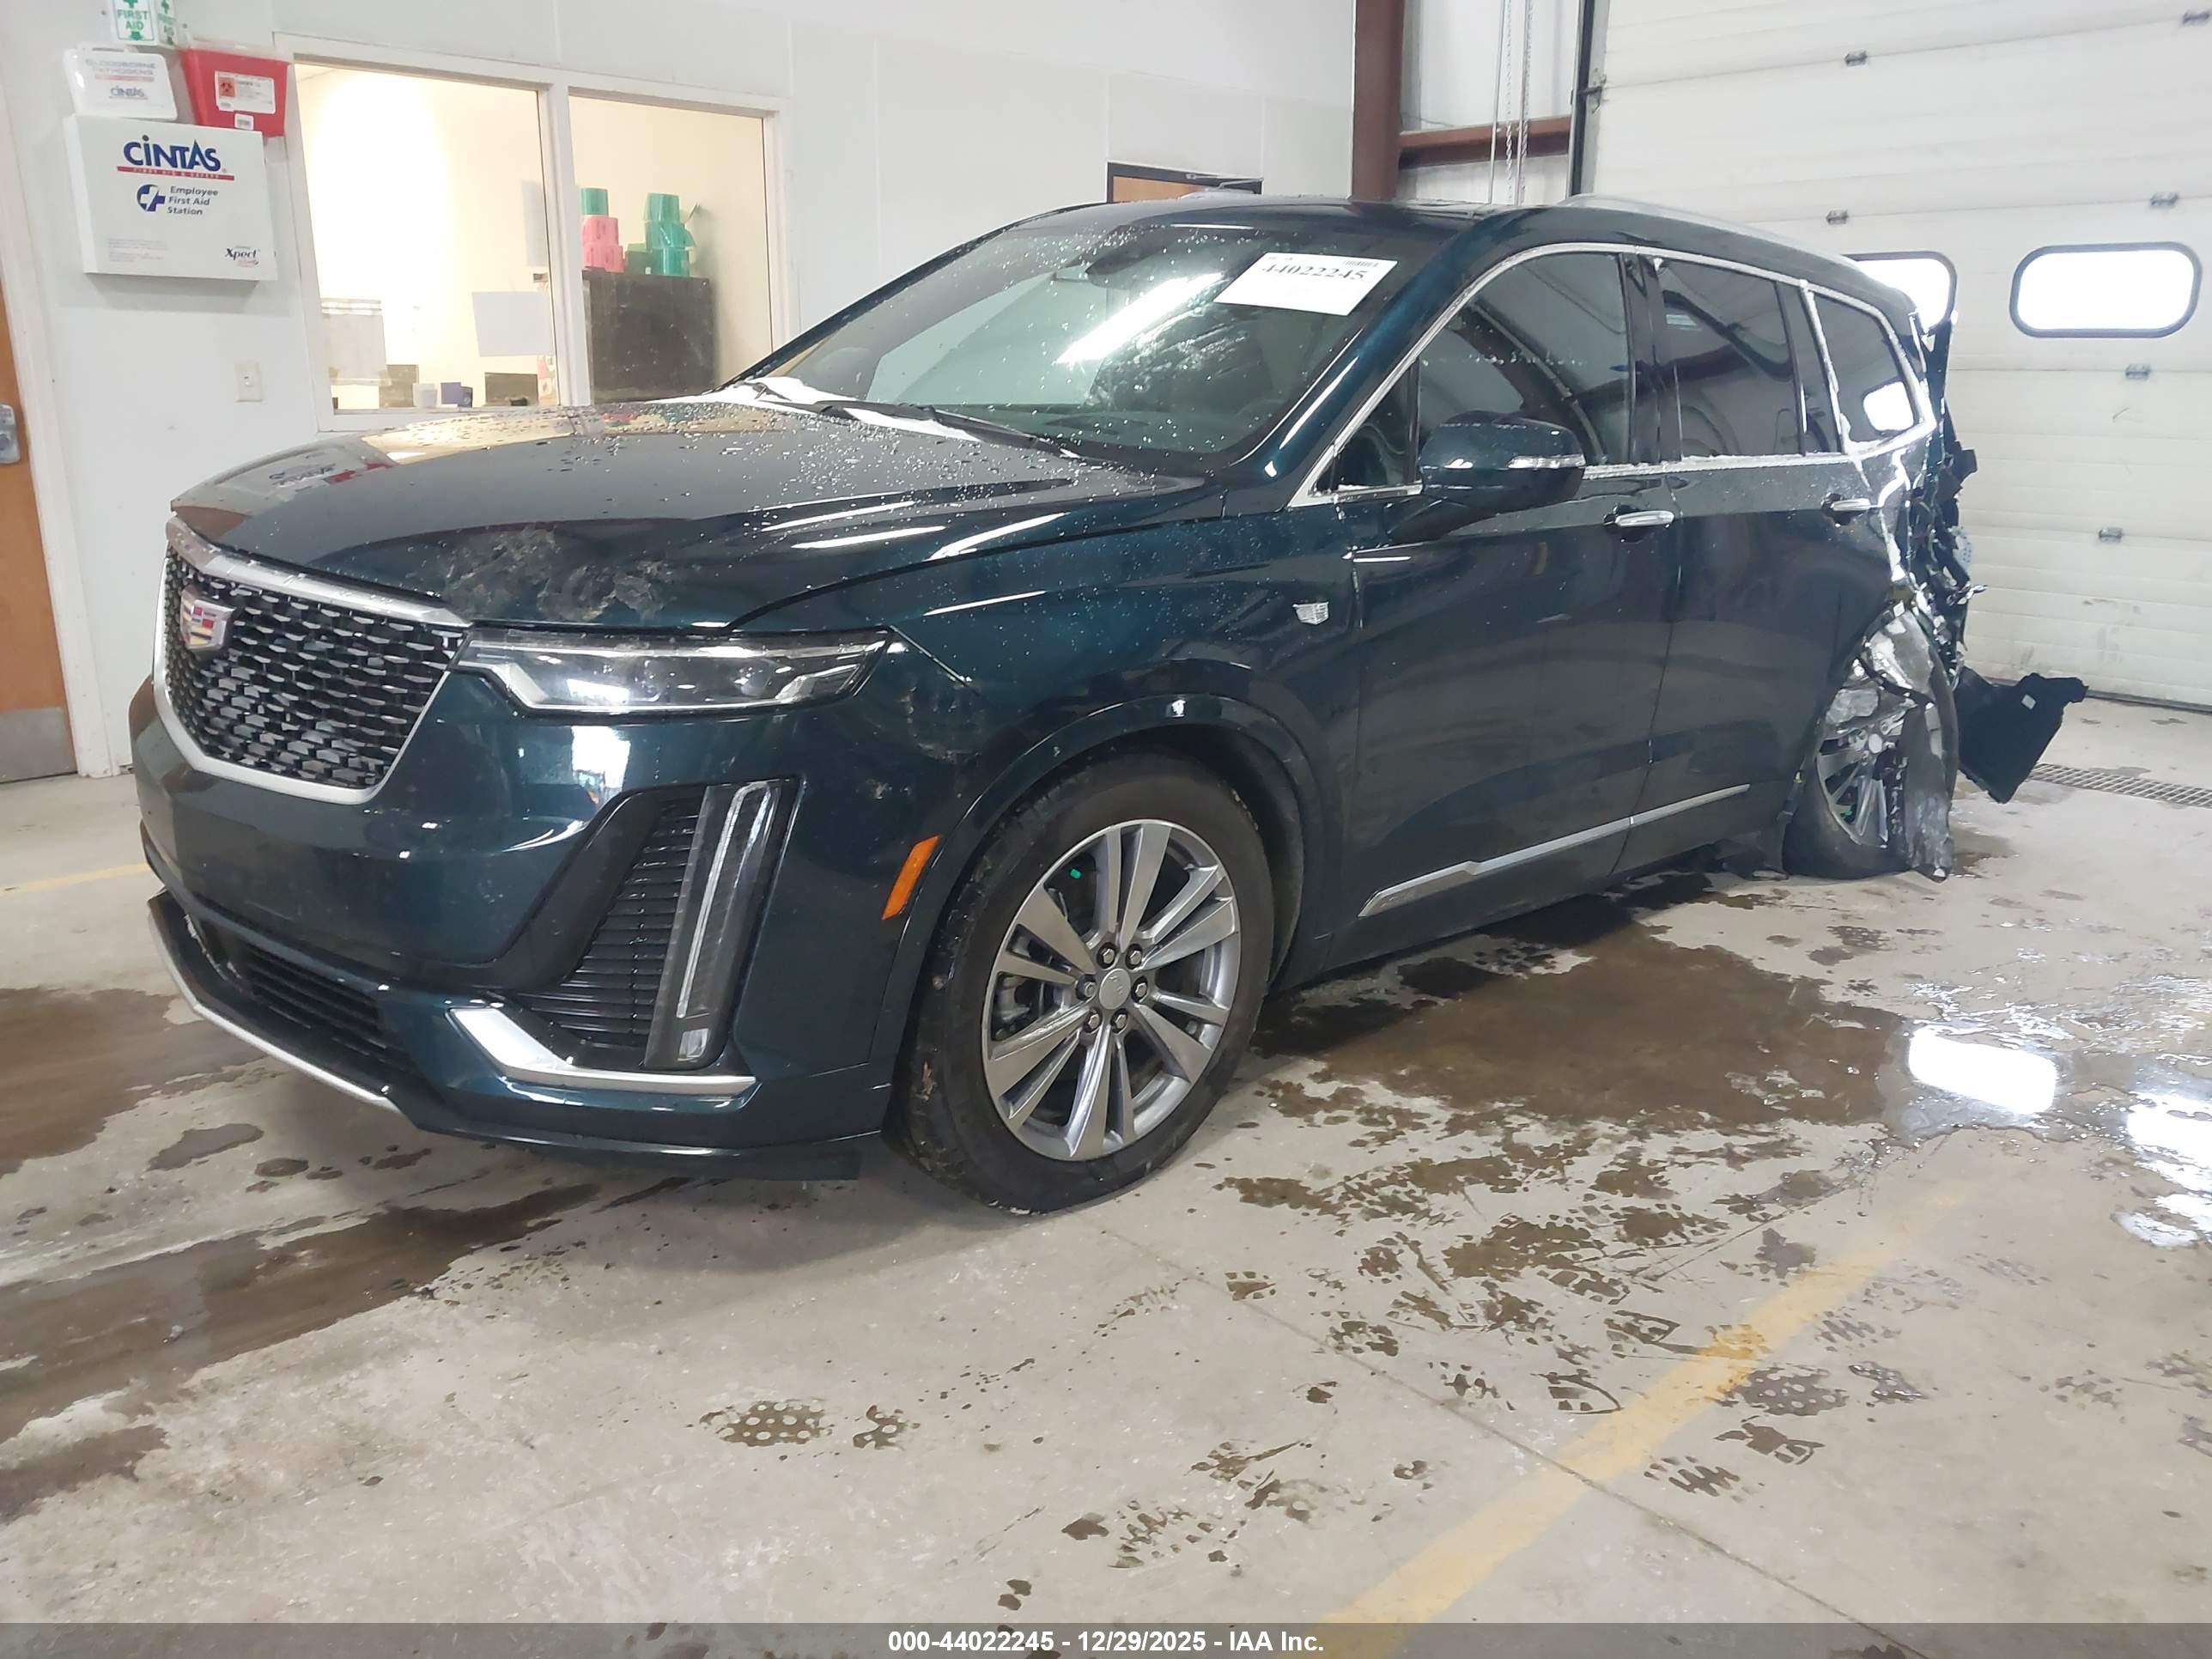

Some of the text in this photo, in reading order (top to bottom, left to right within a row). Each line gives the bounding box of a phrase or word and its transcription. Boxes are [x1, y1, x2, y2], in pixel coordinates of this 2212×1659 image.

[117, 9, 151, 21] FIRST
[125, 20, 144, 31] AID
[170, 186, 219, 198] Employee
[168, 196, 210, 206] First Aid
[167, 206, 204, 216] Station
[1261, 264, 1368, 280] 44022245
